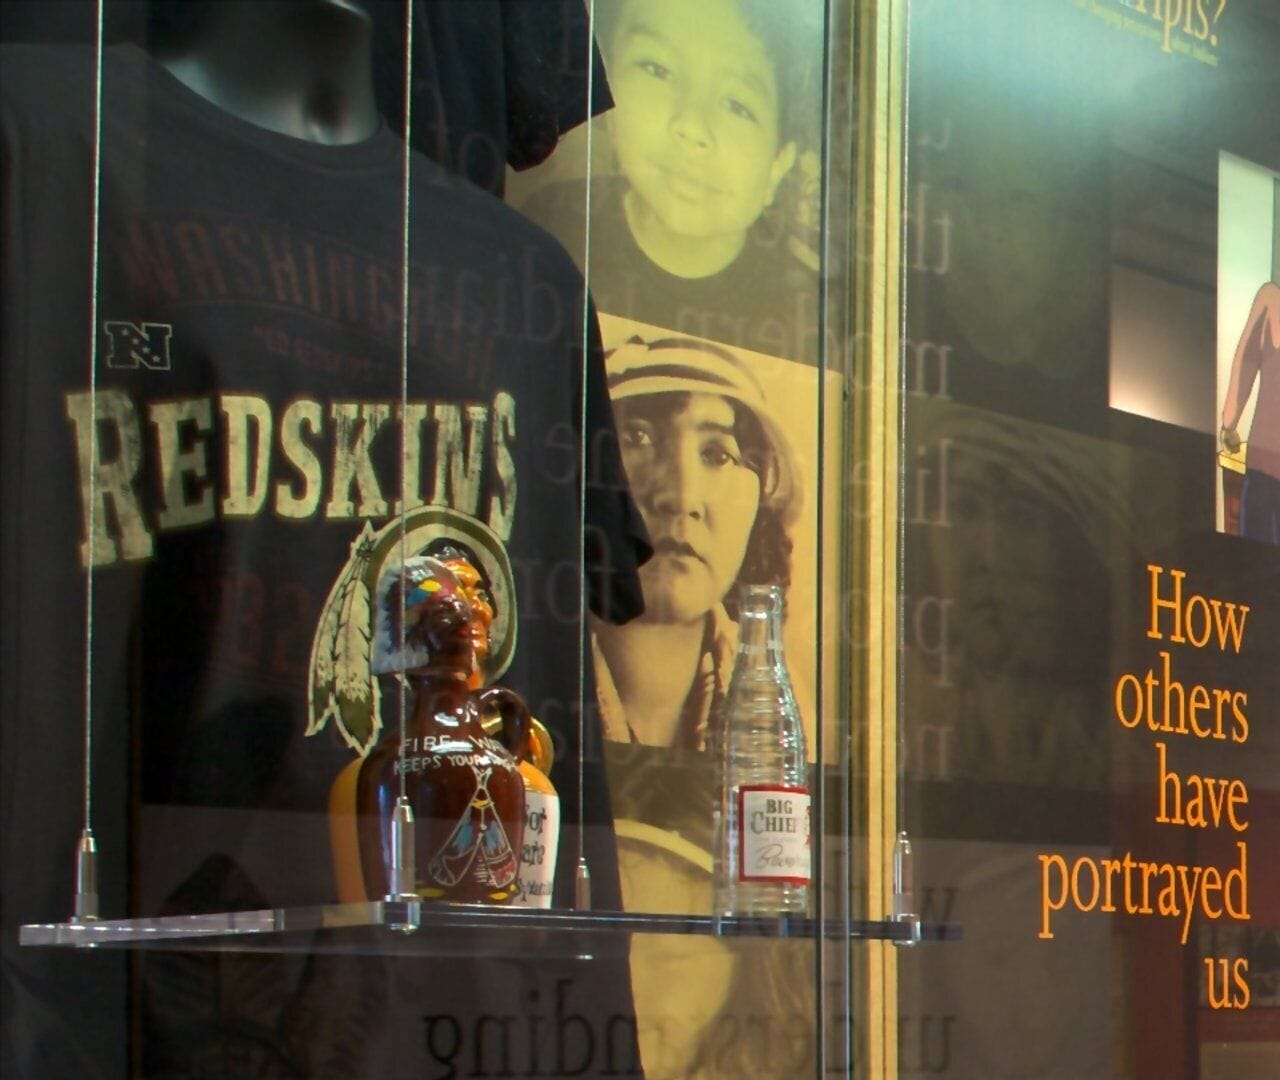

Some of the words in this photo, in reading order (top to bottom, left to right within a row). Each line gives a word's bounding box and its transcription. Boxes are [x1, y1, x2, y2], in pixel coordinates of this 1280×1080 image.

[64, 389, 518, 569] REDSKINS
[1147, 565, 1250, 654] How
[1115, 652, 1249, 743] others
[766, 799, 793, 814] BIG
[1155, 743, 1249, 832] have
[1039, 842, 1251, 945] portrayed
[1205, 956, 1251, 1010] us
